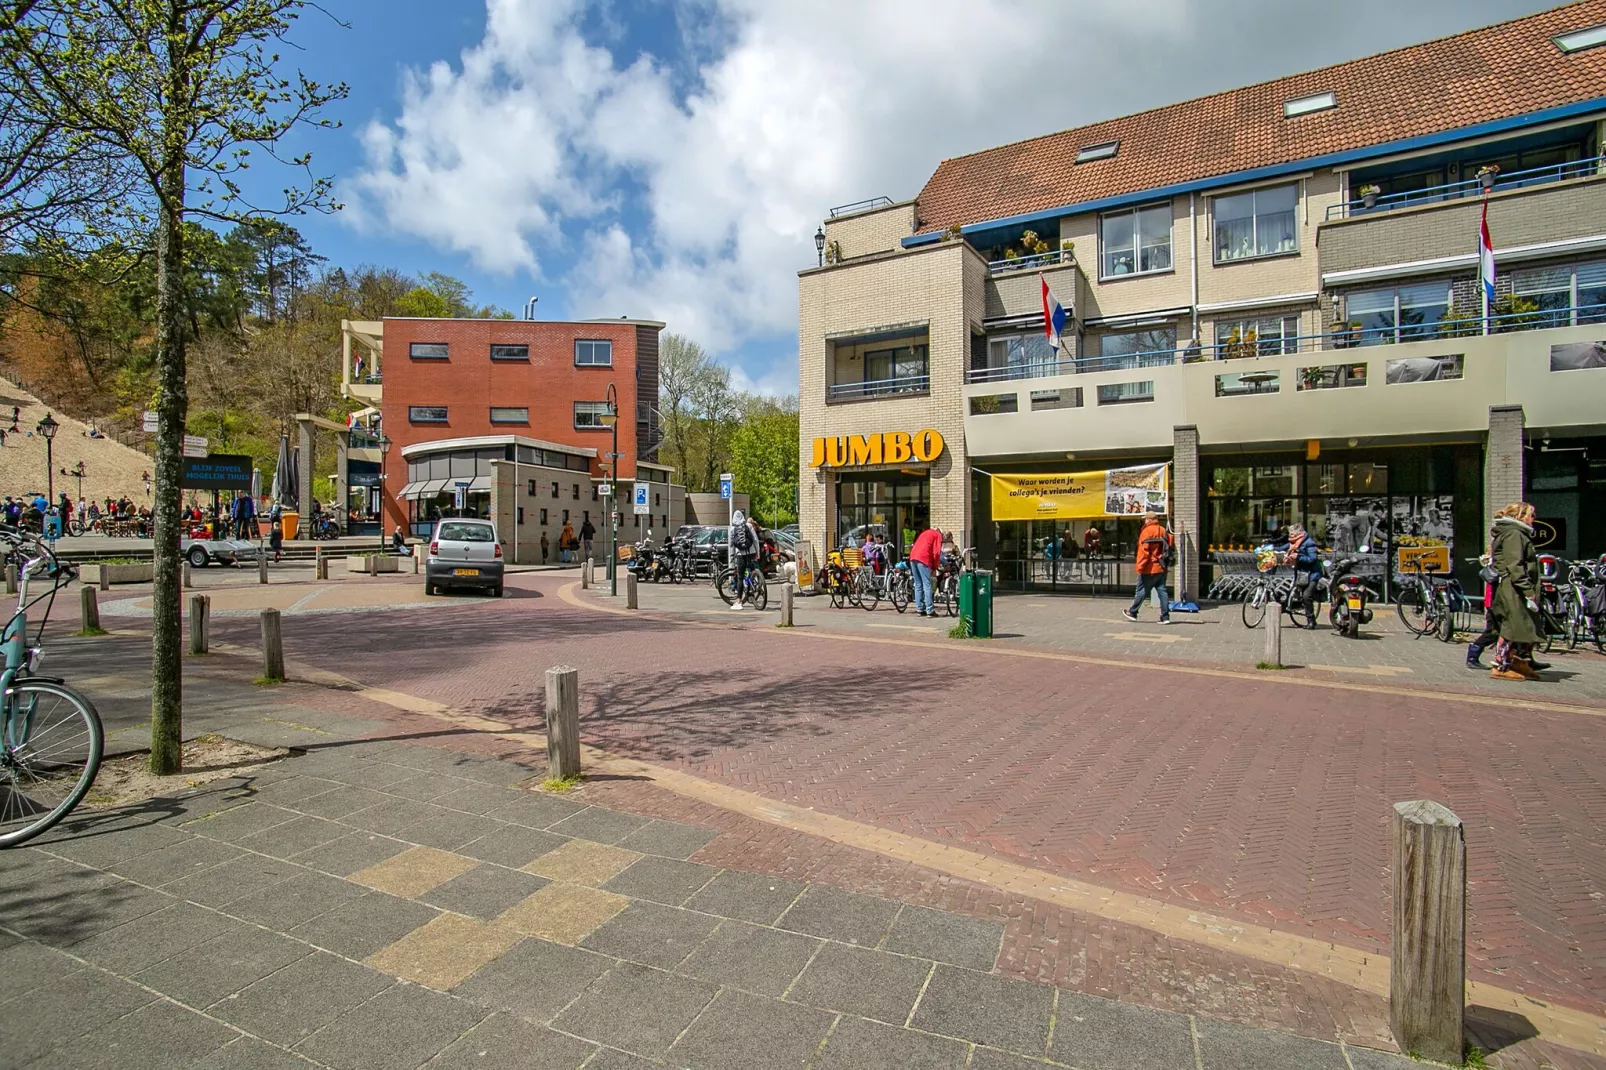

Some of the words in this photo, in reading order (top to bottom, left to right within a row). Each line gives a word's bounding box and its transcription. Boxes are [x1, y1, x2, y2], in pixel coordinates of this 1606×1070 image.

[808, 428, 944, 468] JUMBO
[1067, 476, 1074, 485] je
[1009, 488, 1039, 497] collega's
[1040, 488, 1047, 497] je
[1049, 486, 1085, 495] vrienden?
